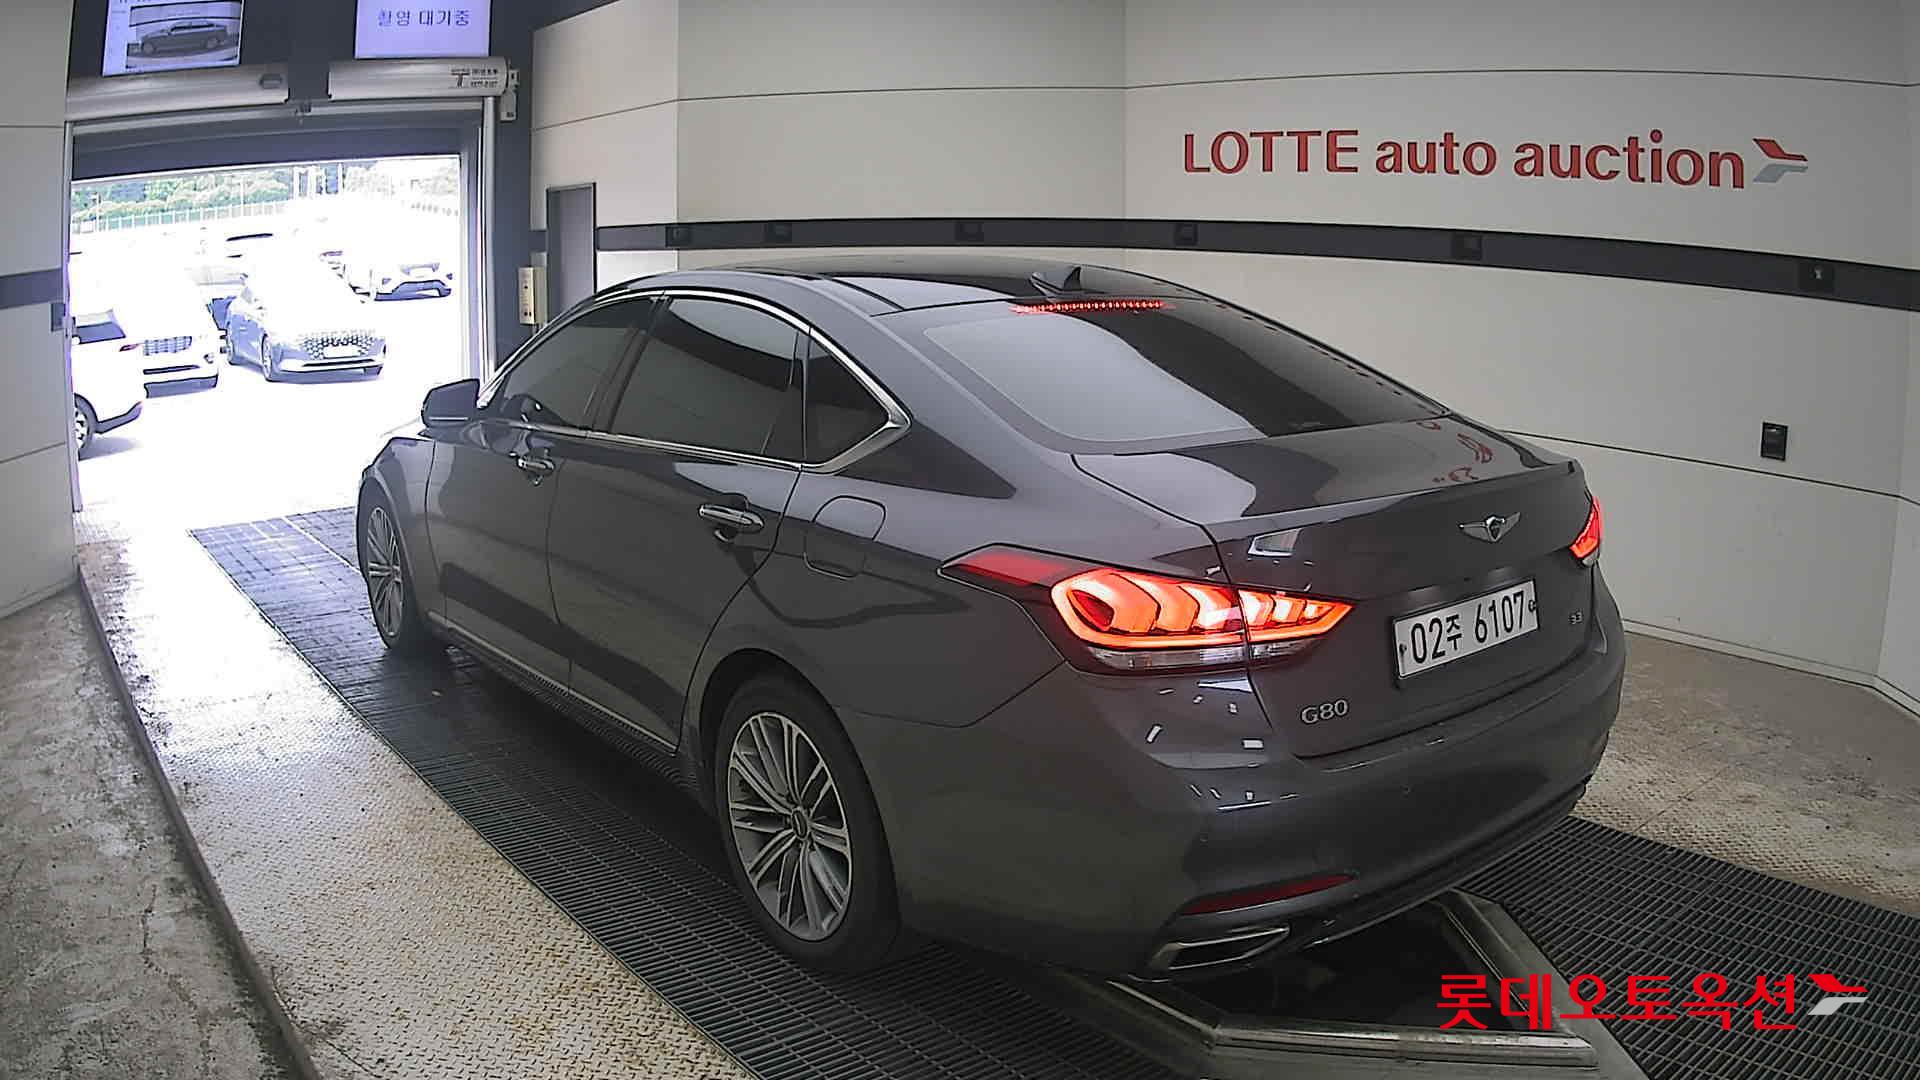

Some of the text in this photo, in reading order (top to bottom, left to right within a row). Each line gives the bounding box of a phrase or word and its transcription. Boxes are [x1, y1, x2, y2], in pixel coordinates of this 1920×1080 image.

[1184, 129, 1745, 189] LOTTE auto auction
[1410, 590, 1525, 664] 02주 6107
[1301, 699, 1348, 724] G80
